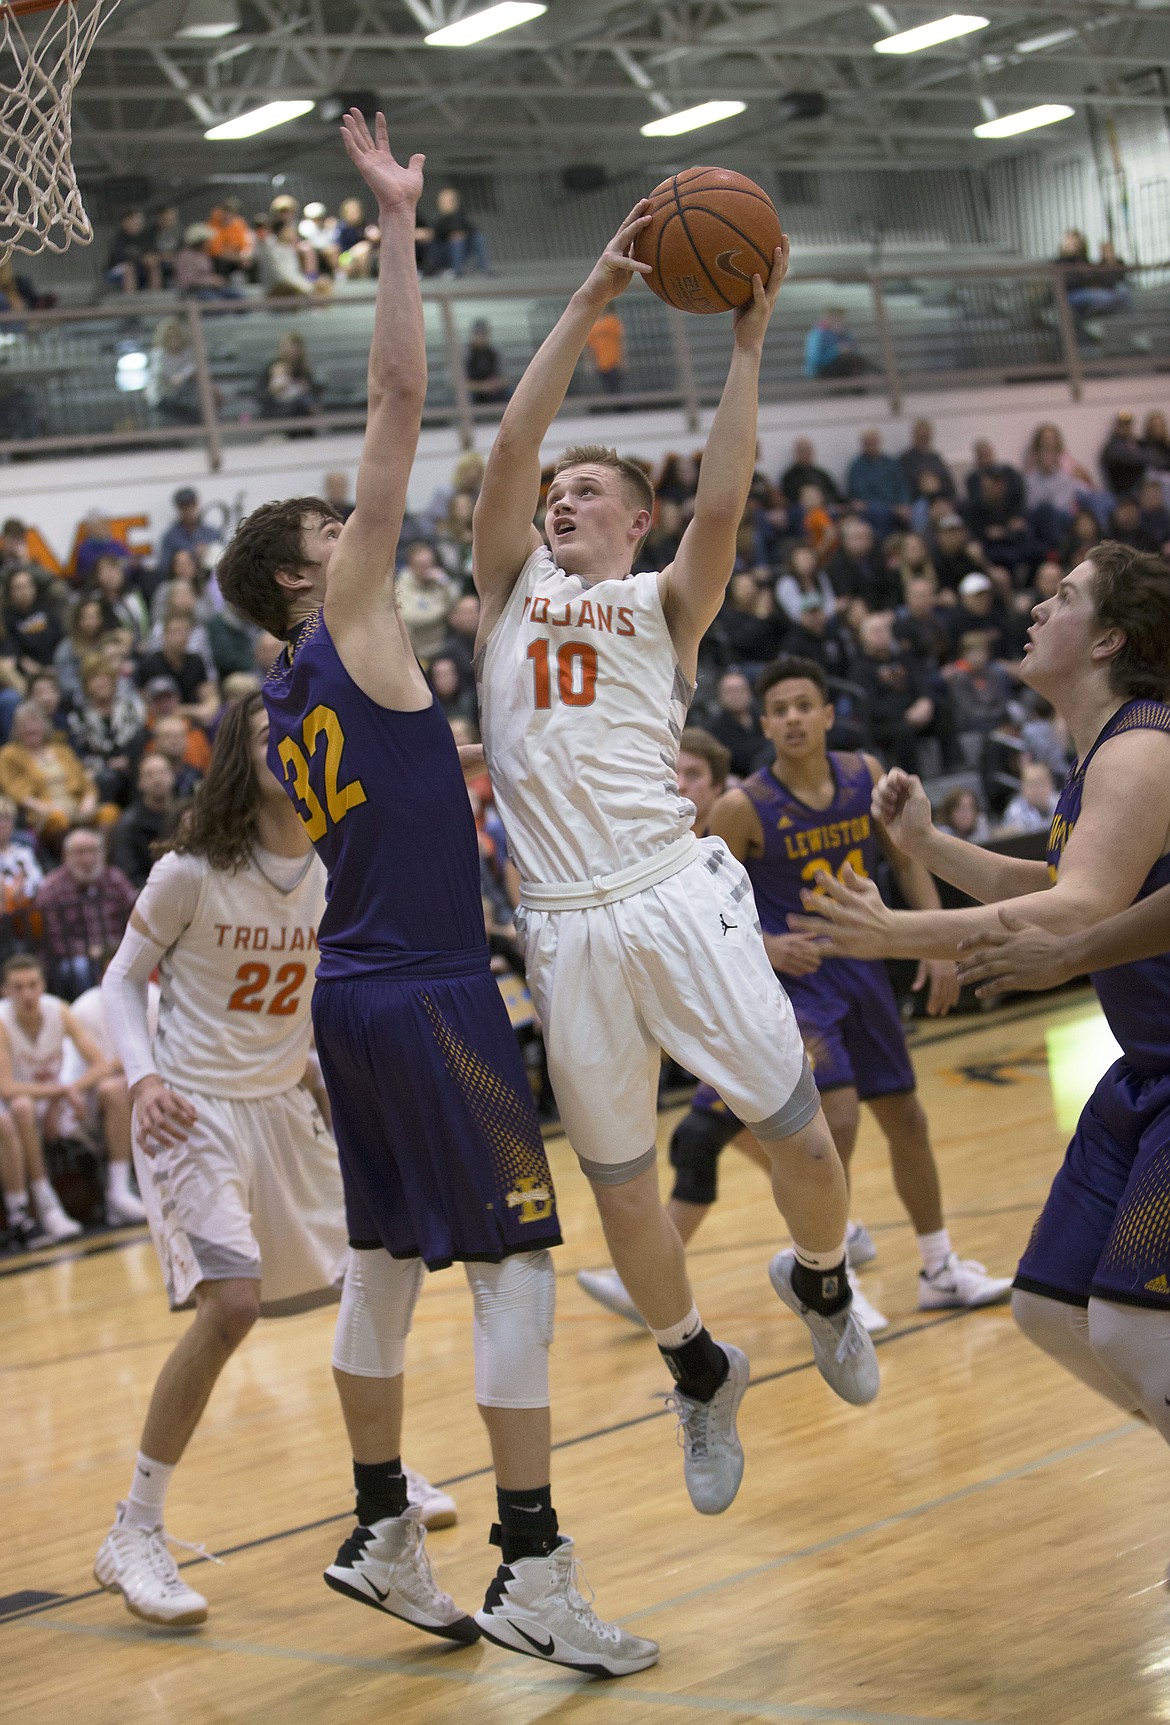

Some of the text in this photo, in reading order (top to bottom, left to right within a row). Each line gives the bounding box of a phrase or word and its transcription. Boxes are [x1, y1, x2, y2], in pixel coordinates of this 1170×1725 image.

[520, 596, 637, 637] OJANS
[526, 636, 599, 711] 10
[276, 703, 368, 843] 32
[783, 813, 871, 860] LEWISTON
[213, 922, 319, 952] TROJAN
[226, 961, 308, 1016] 22
